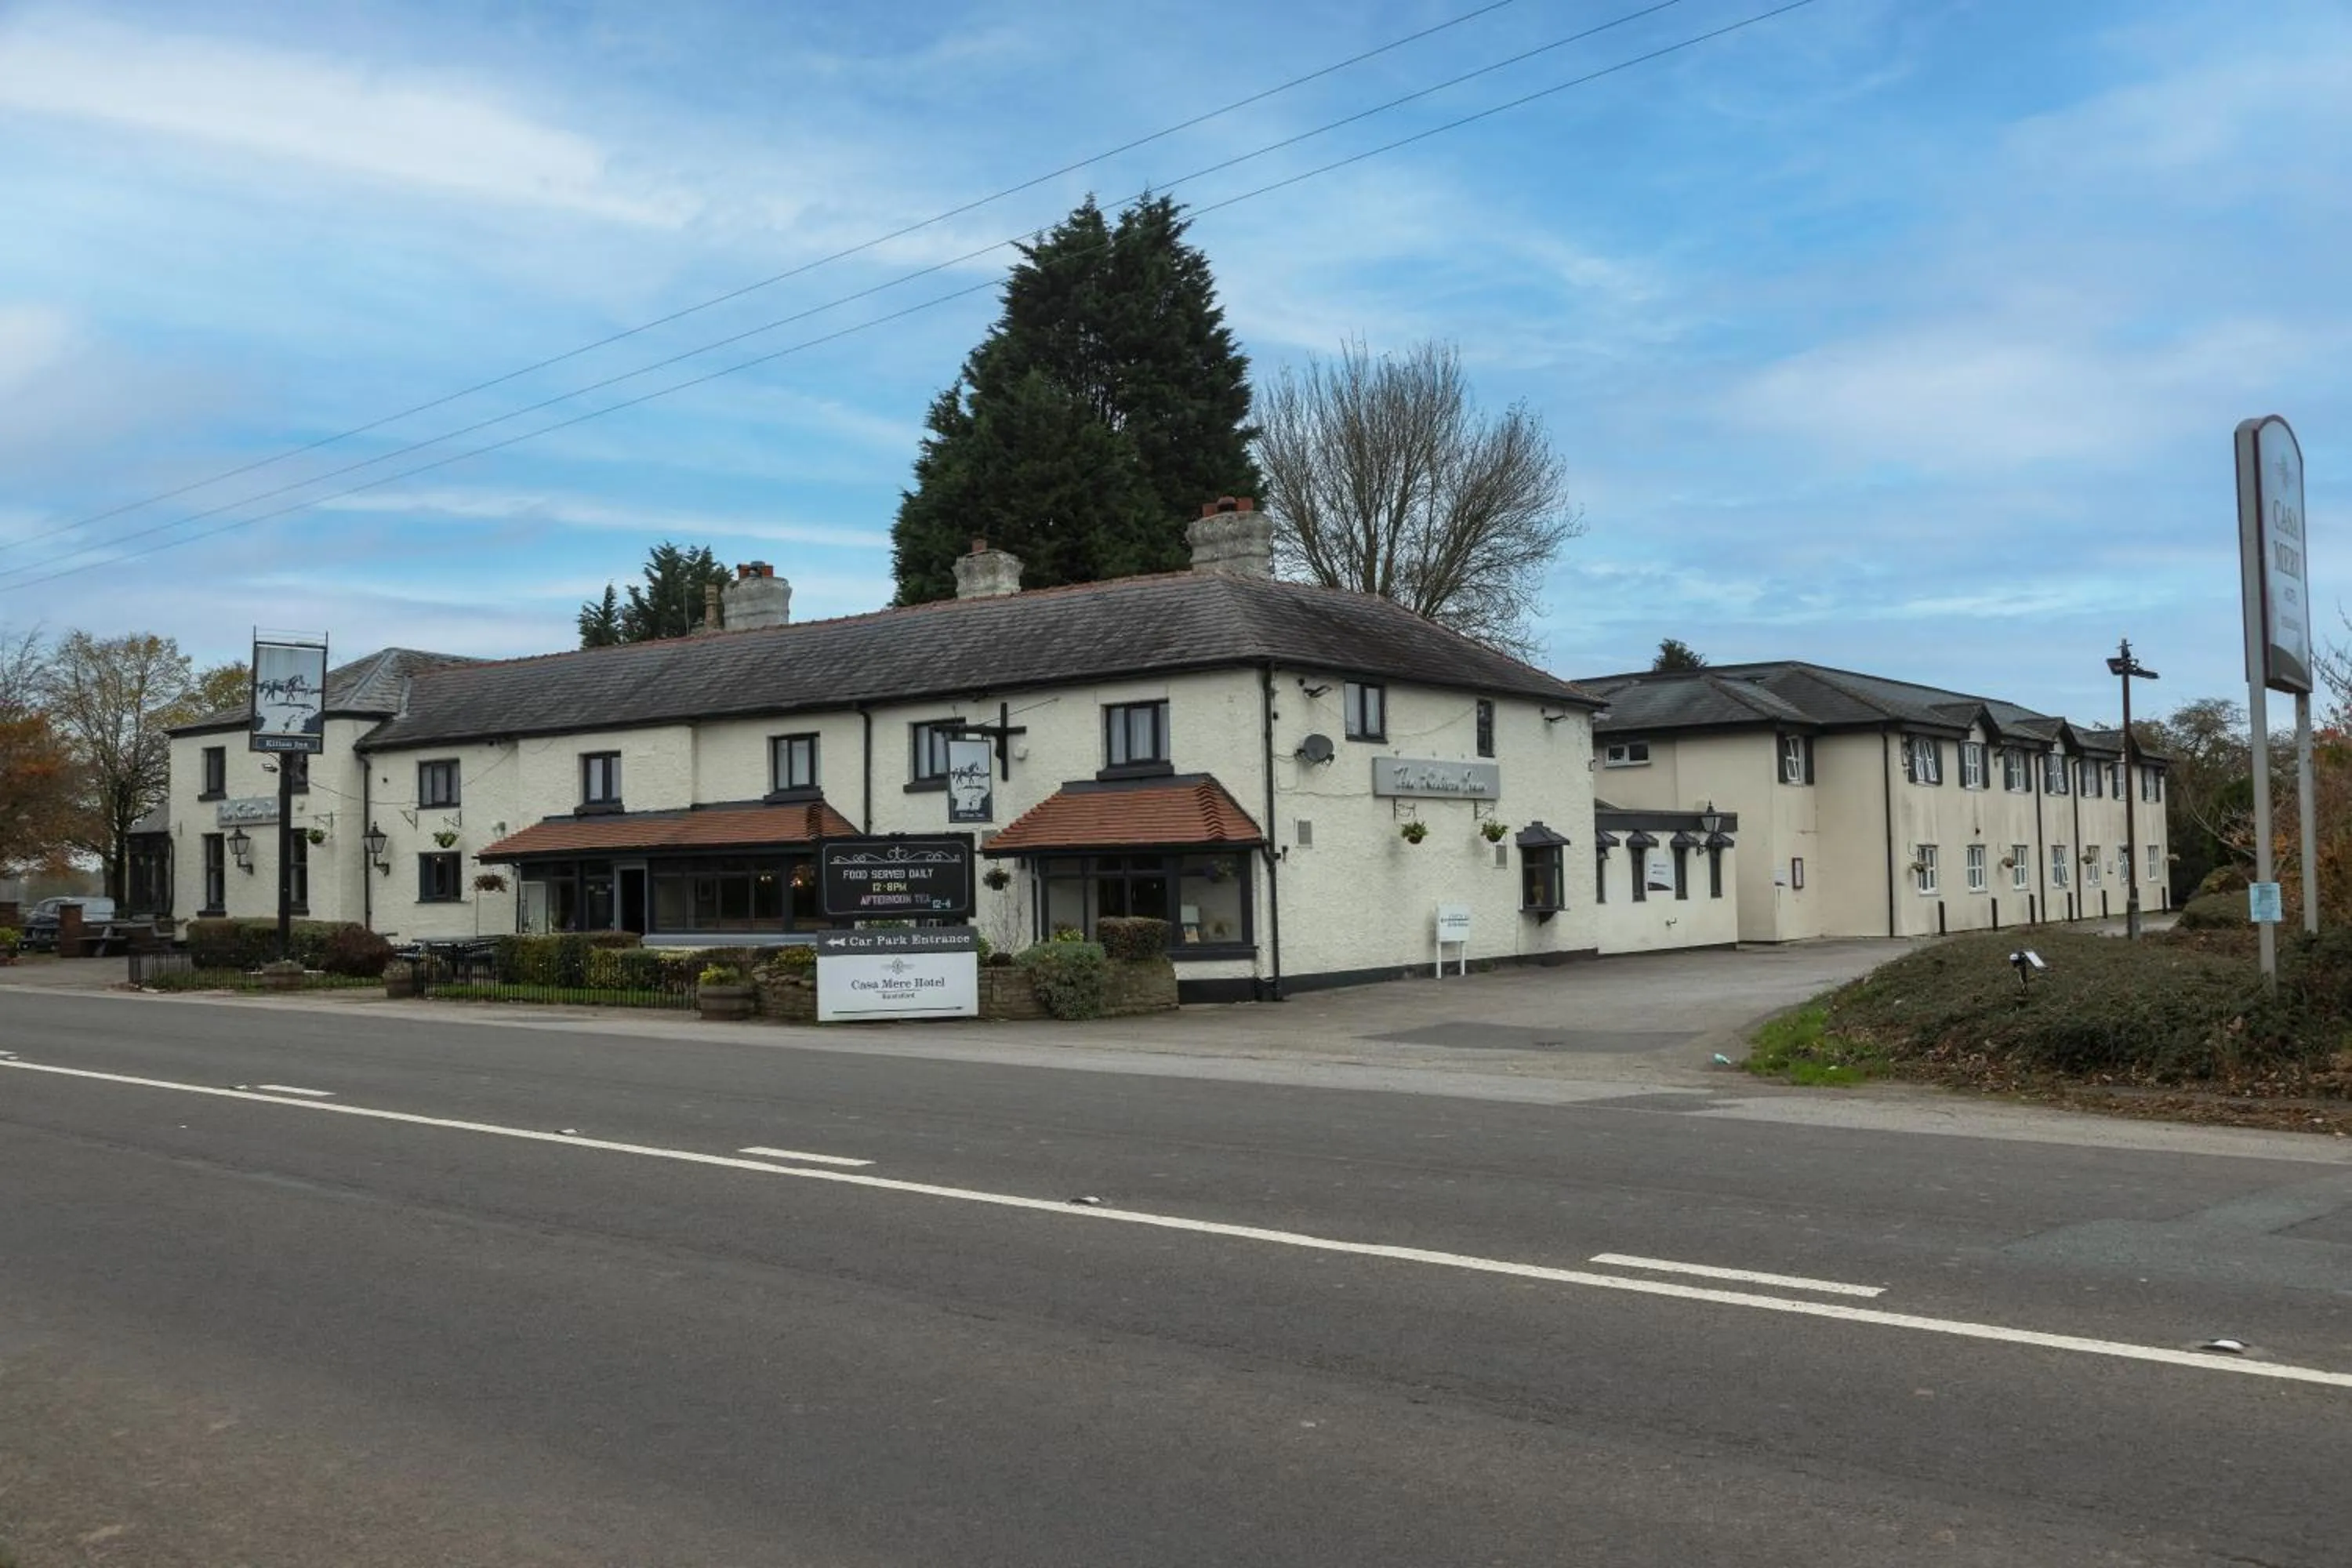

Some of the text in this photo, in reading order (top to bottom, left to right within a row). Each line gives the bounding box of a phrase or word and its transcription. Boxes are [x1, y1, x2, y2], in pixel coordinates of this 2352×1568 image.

[843, 868, 934, 879] FOOD SERVED DAILY
[860, 894, 912, 906] AFTERNOON
[914, 893, 931, 902] TEA
[849, 934, 970, 946] Car Park Entrance
[851, 977, 945, 990] Casa Mere Hotel
